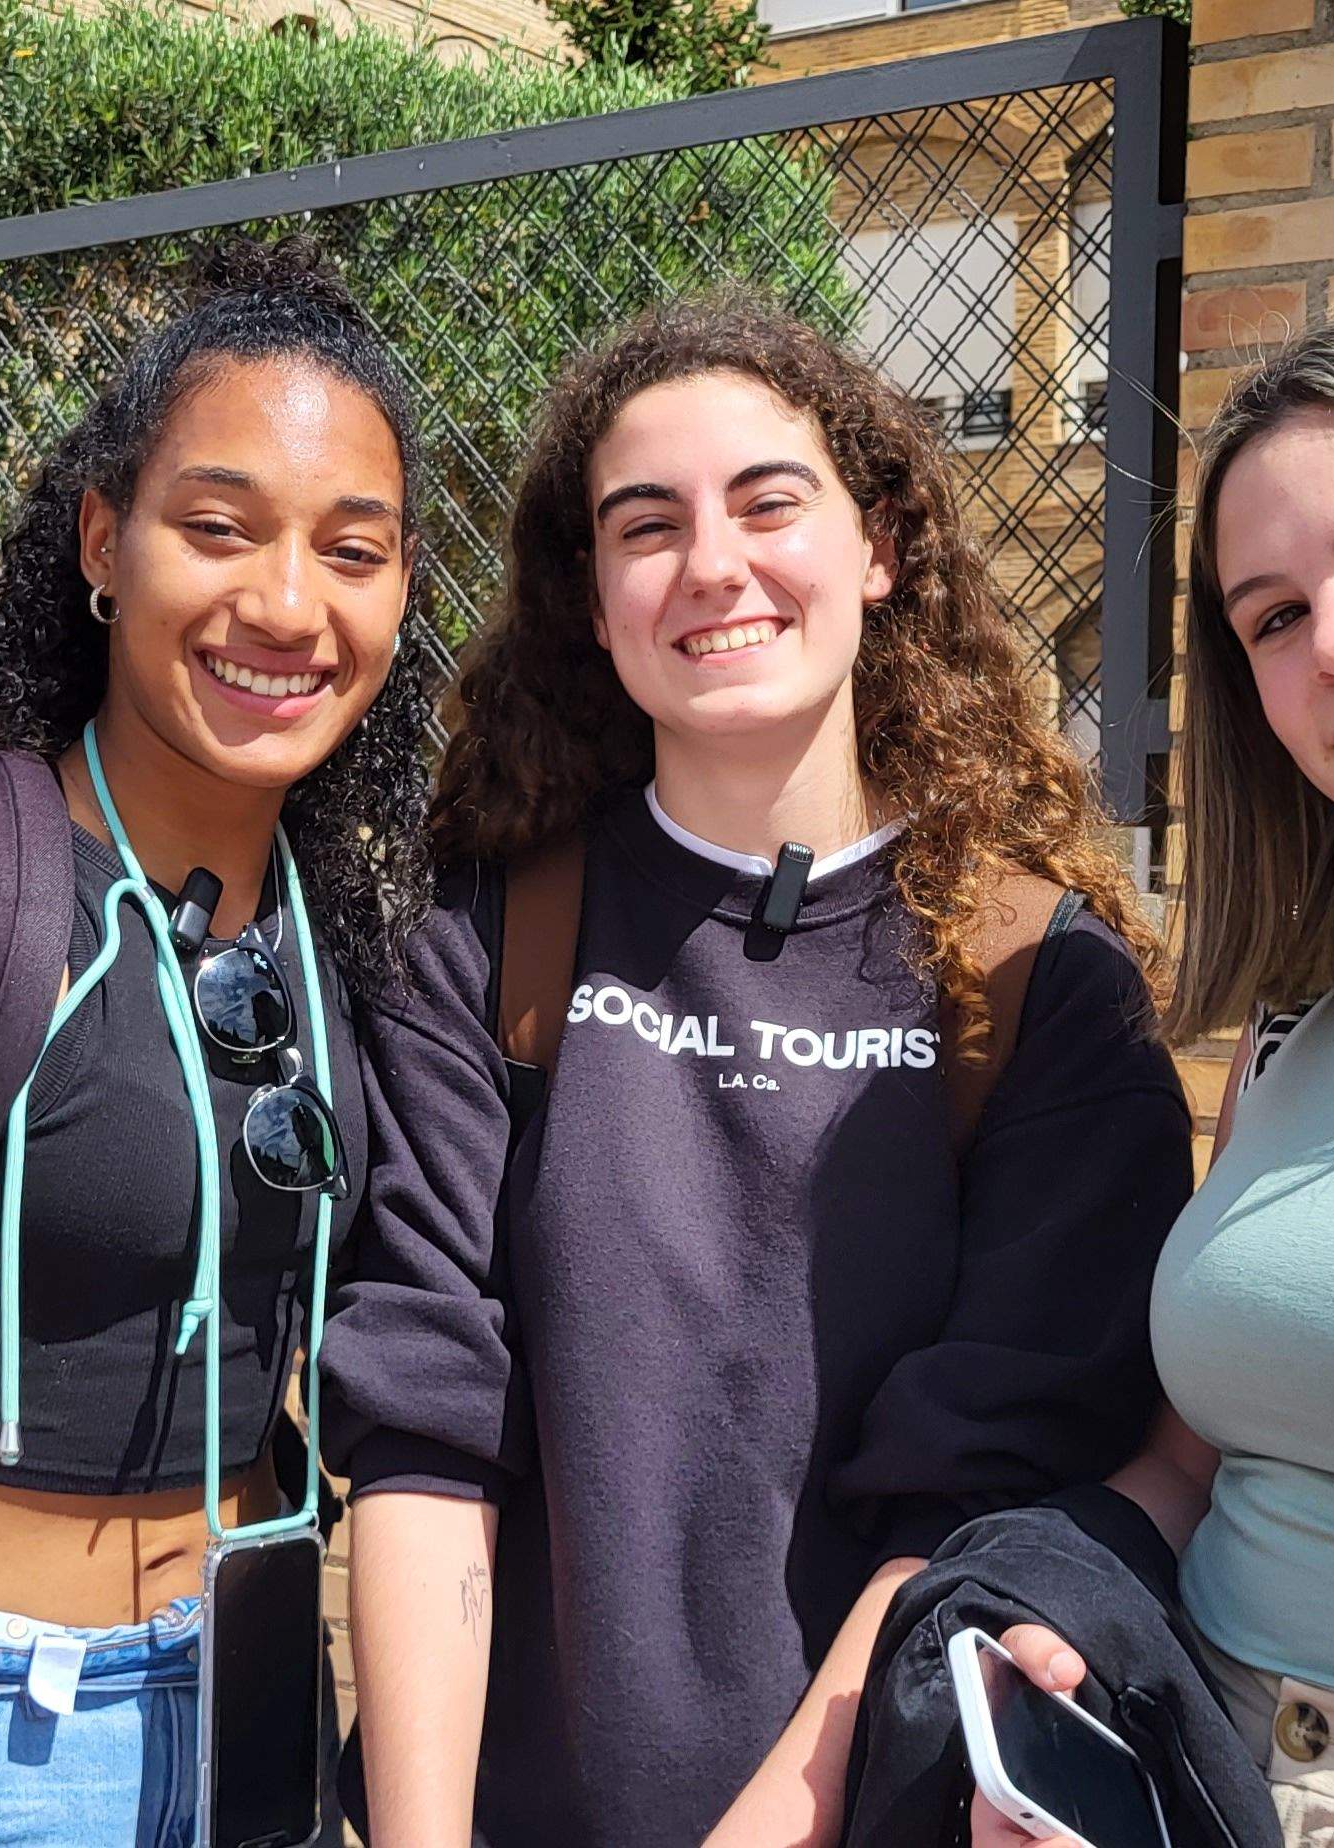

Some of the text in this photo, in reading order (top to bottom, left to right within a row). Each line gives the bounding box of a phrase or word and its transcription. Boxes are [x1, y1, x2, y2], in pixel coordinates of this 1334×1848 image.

[567, 984, 941, 1070] SOCIAL TOURIS
[718, 1073, 749, 1089] L.A.
